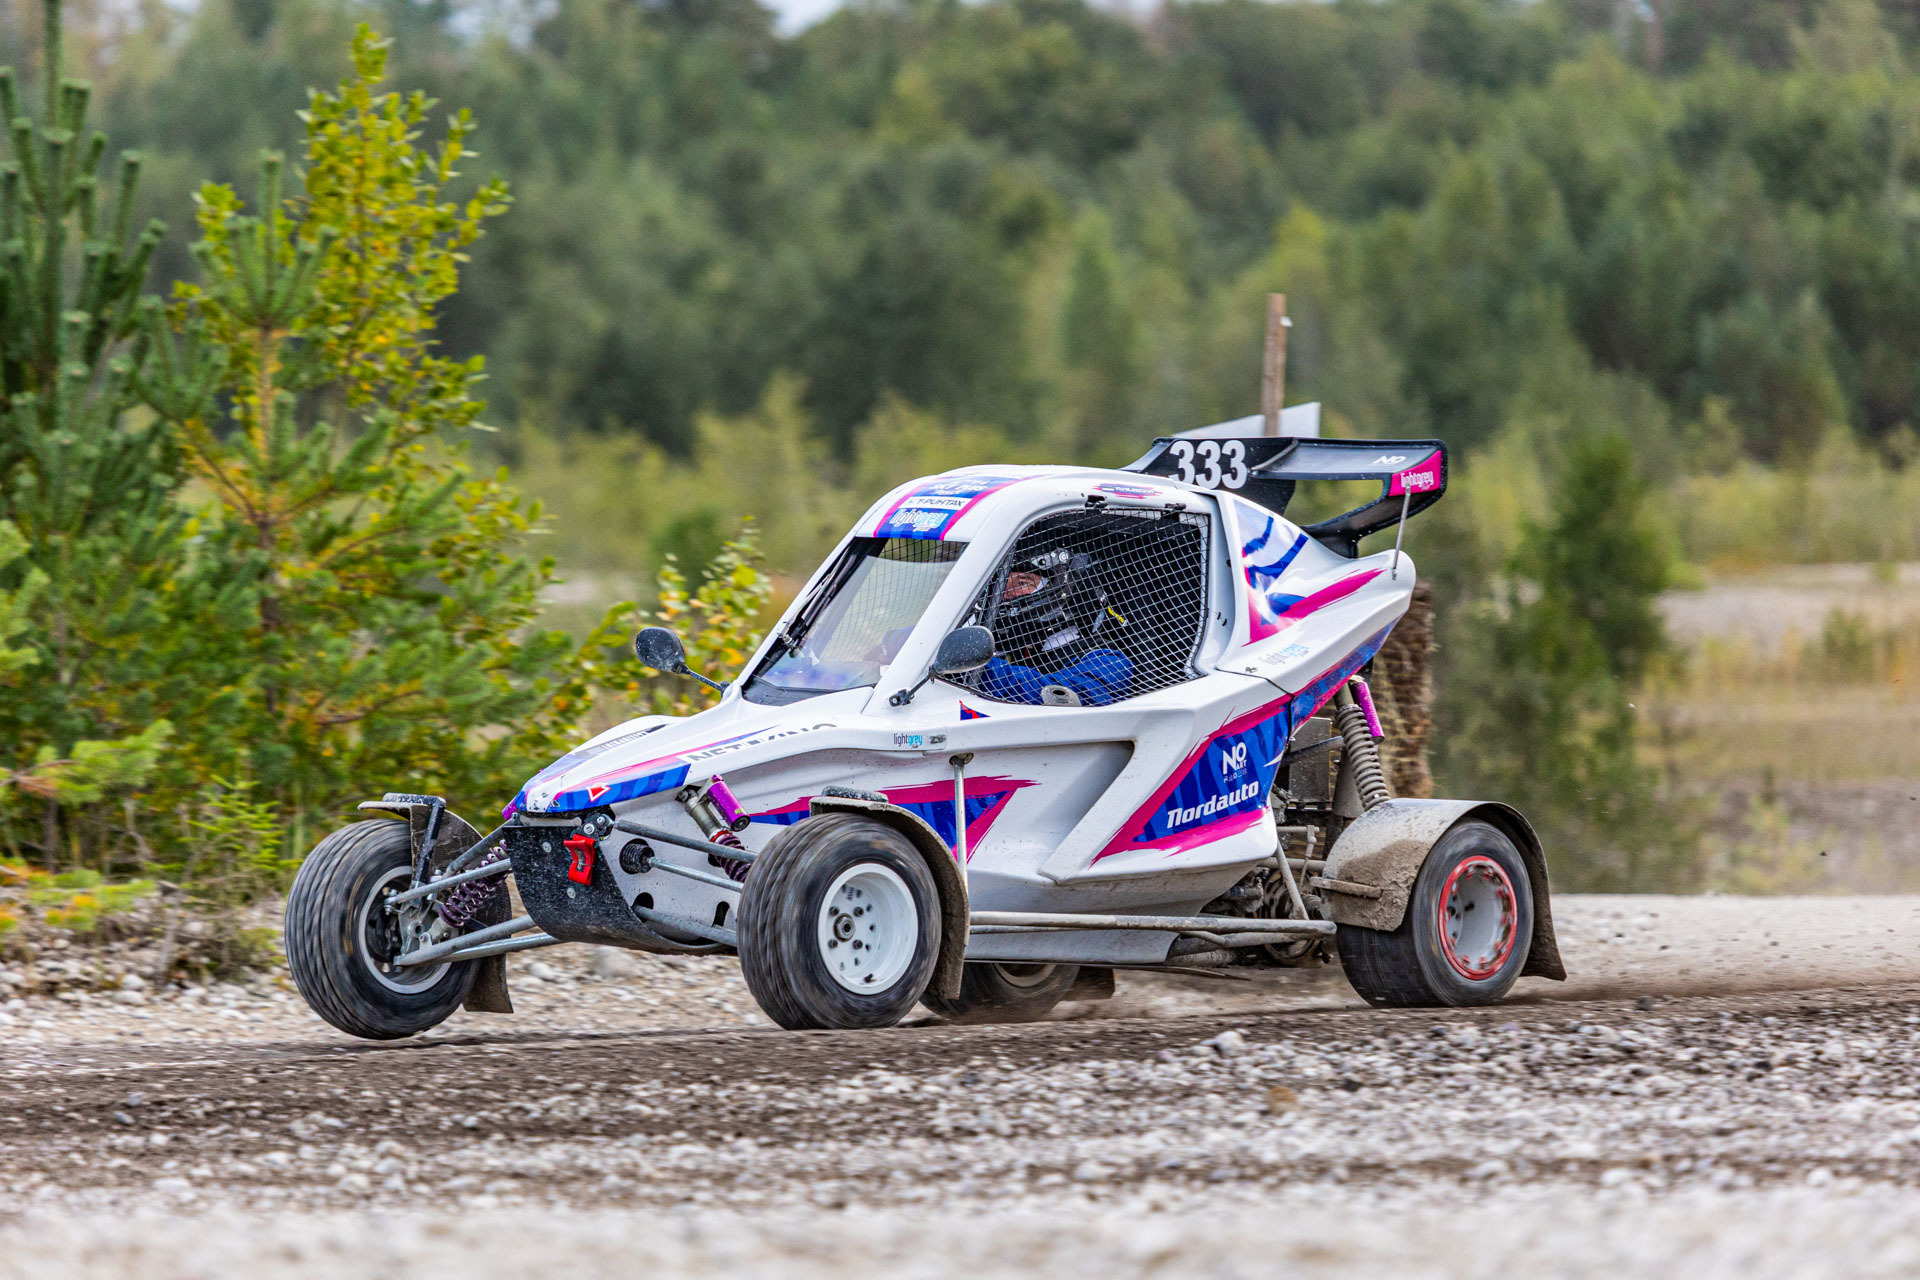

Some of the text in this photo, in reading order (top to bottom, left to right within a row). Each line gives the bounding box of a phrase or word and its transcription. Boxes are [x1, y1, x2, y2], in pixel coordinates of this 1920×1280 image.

[1168, 439, 1247, 490] 333
[888, 508, 949, 530] lightgrey
[893, 732, 923, 748] lightgrey
[1222, 741, 1247, 776] NO
